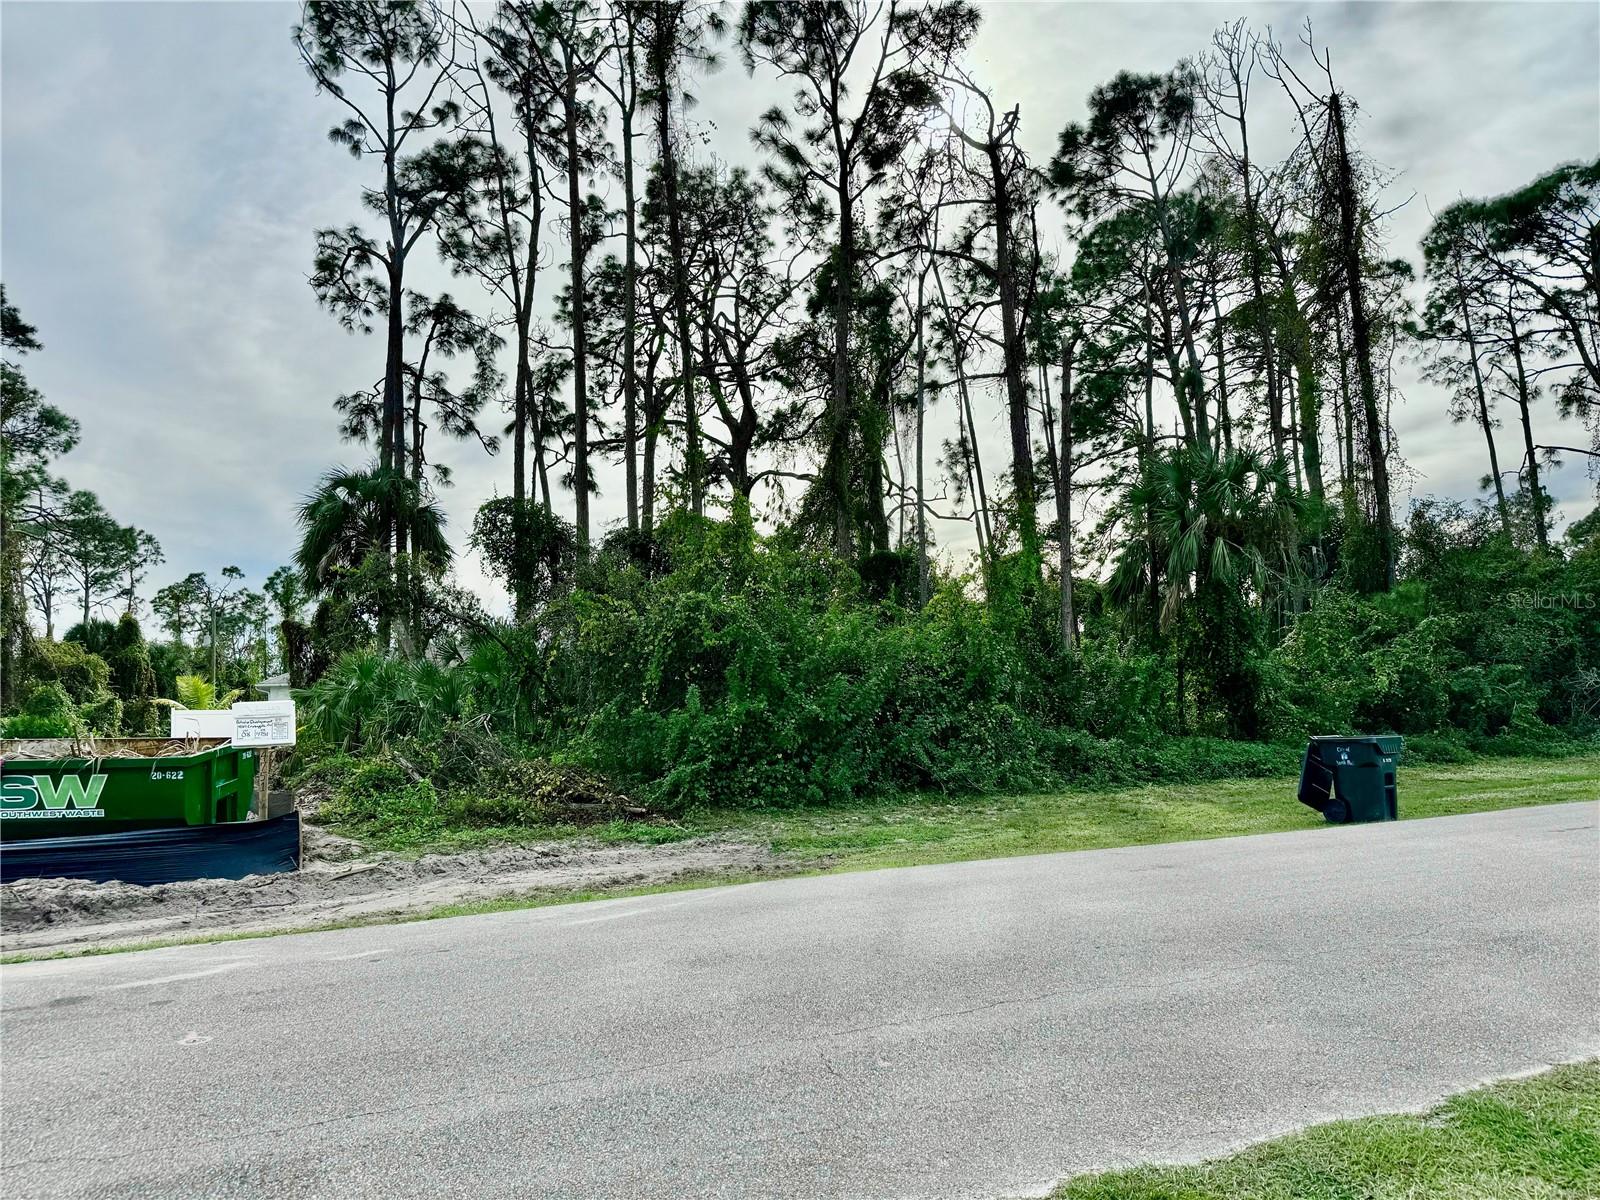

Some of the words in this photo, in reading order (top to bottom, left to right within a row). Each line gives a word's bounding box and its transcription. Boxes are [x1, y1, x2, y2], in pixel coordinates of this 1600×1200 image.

[151, 770, 184, 780] 20-622
[0, 774, 109, 810] SW
[64, 810, 104, 818] WASTE
